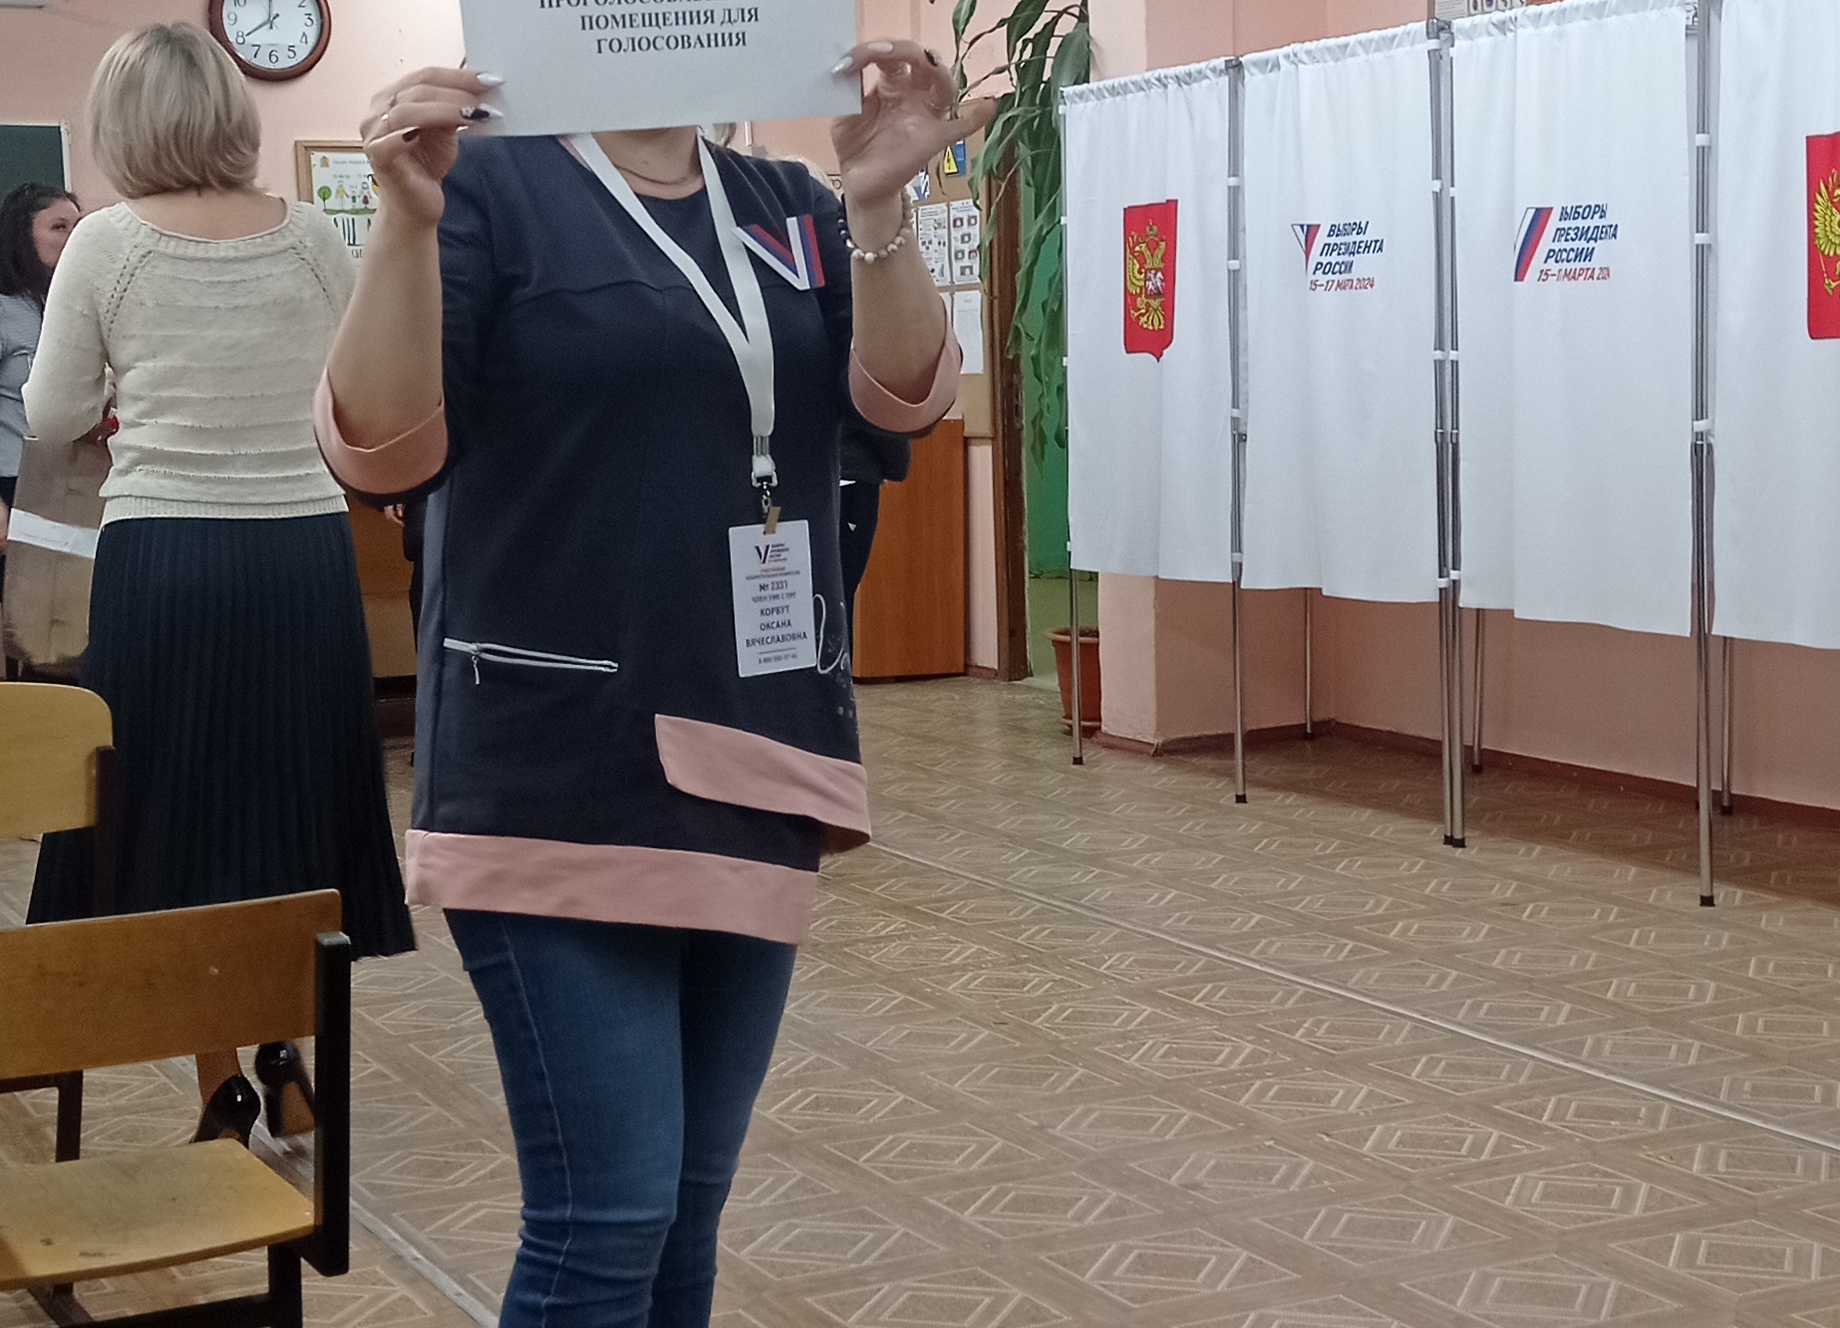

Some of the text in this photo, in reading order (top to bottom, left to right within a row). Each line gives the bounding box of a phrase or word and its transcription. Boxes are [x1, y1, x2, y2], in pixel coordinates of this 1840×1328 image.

[227, 12, 238, 26] 9
[304, 13, 315, 28] 3
[580, 7, 760, 31] ПОМЕЩЕНИЯ ДЛЯ
[235, 31, 246, 46] 8
[299, 31, 309, 45] 4
[596, 31, 748, 54] ГОЛОСОВАНИЯ
[251, 44, 262, 59] 7
[268, 49, 279, 64] 6
[287, 45, 297, 60] 5
[1563, 267, 1596, 282] МАРТА
[760, 605, 790, 617] КОРБУТ
[759, 619, 792, 631] ОКСАНА
[745, 631, 808, 648] ВЯЧЕСЛАВОВНА
